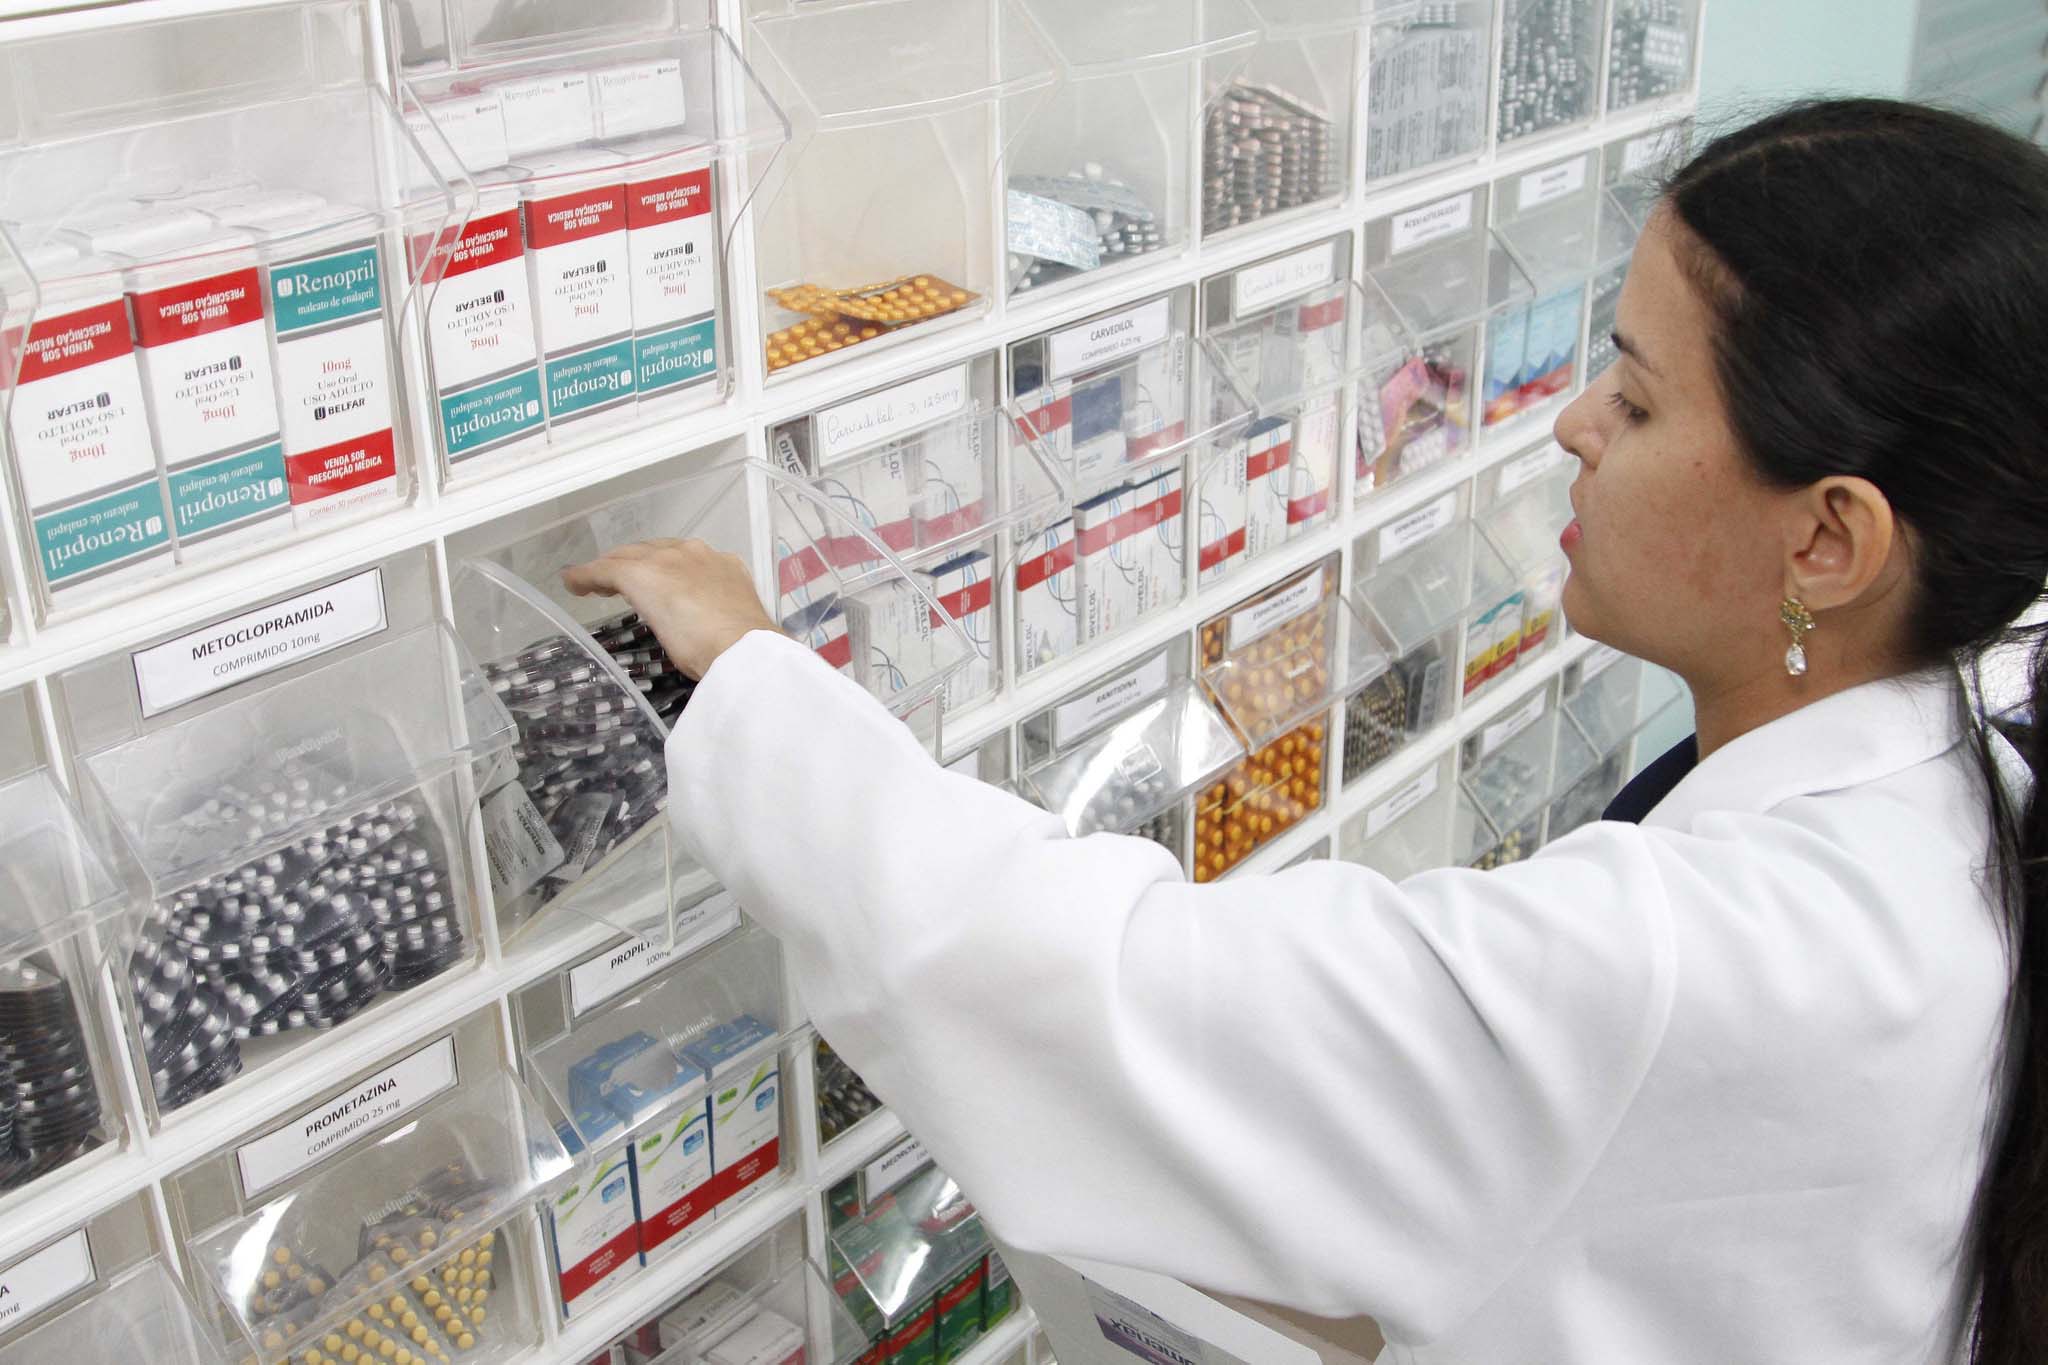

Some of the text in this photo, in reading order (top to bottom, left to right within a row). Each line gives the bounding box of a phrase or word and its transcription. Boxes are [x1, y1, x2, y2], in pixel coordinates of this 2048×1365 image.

[575, 200, 613, 216] PRESCRIÇÃO
[656, 198, 688, 213] VENDA SOB
[564, 214, 600, 231] VENDA SOB
[466, 227, 508, 247] PRESCRIÇÃO
[454, 249, 469, 263] SOB
[470, 243, 494, 257] VENDA
[654, 246, 683, 260] BELFAR
[295, 259, 375, 295] Renopril
[562, 264, 595, 280] BELFAR
[159, 287, 245, 319] PRESCRIÇÃO MÉDICA
[297, 287, 374, 315] maleato de enalapril
[455, 295, 492, 313] BELFAR
[181, 304, 229, 326] VENDA SOB
[56, 321, 112, 345] PRESCRIÇÃO
[1090, 319, 1134, 342] CARVEDILOL
[41, 340, 94, 364] VENDA SOB
[470, 335, 499, 350] 10mg
[184, 361, 227, 380] BELFAR
[322, 358, 352, 374] 10mg
[582, 362, 592, 373] de
[641, 350, 702, 383] Renopril
[303, 380, 374, 406] USO ADULTO
[318, 374, 358, 390] Uso Oral
[552, 373, 619, 408] Renopril
[47, 399, 95, 420] BELFAR
[328, 398, 365, 415] BELFAR
[450, 385, 522, 418] maleato de enalapril
[203, 404, 236, 423] 10mg
[450, 403, 525, 444] Renopril
[69, 443, 106, 463] 10mg
[324, 449, 365, 469] VENDA SOB
[179, 461, 263, 497] maleato de enalapril
[308, 456, 382, 486] PRESCRIÇÃO MÉDICA
[179, 480, 267, 526] Renopril
[47, 501, 139, 540] maleato de enalapril
[48, 521, 144, 571] Renopril
[191, 600, 335, 661] METOCLOPRAMIDA
[212, 631, 322, 677] COMPRIMIDO 10mg
[305, 1077, 398, 1138] PROMETAZINA
[306, 1098, 401, 1156] COMPRIMIDO 25 mg
